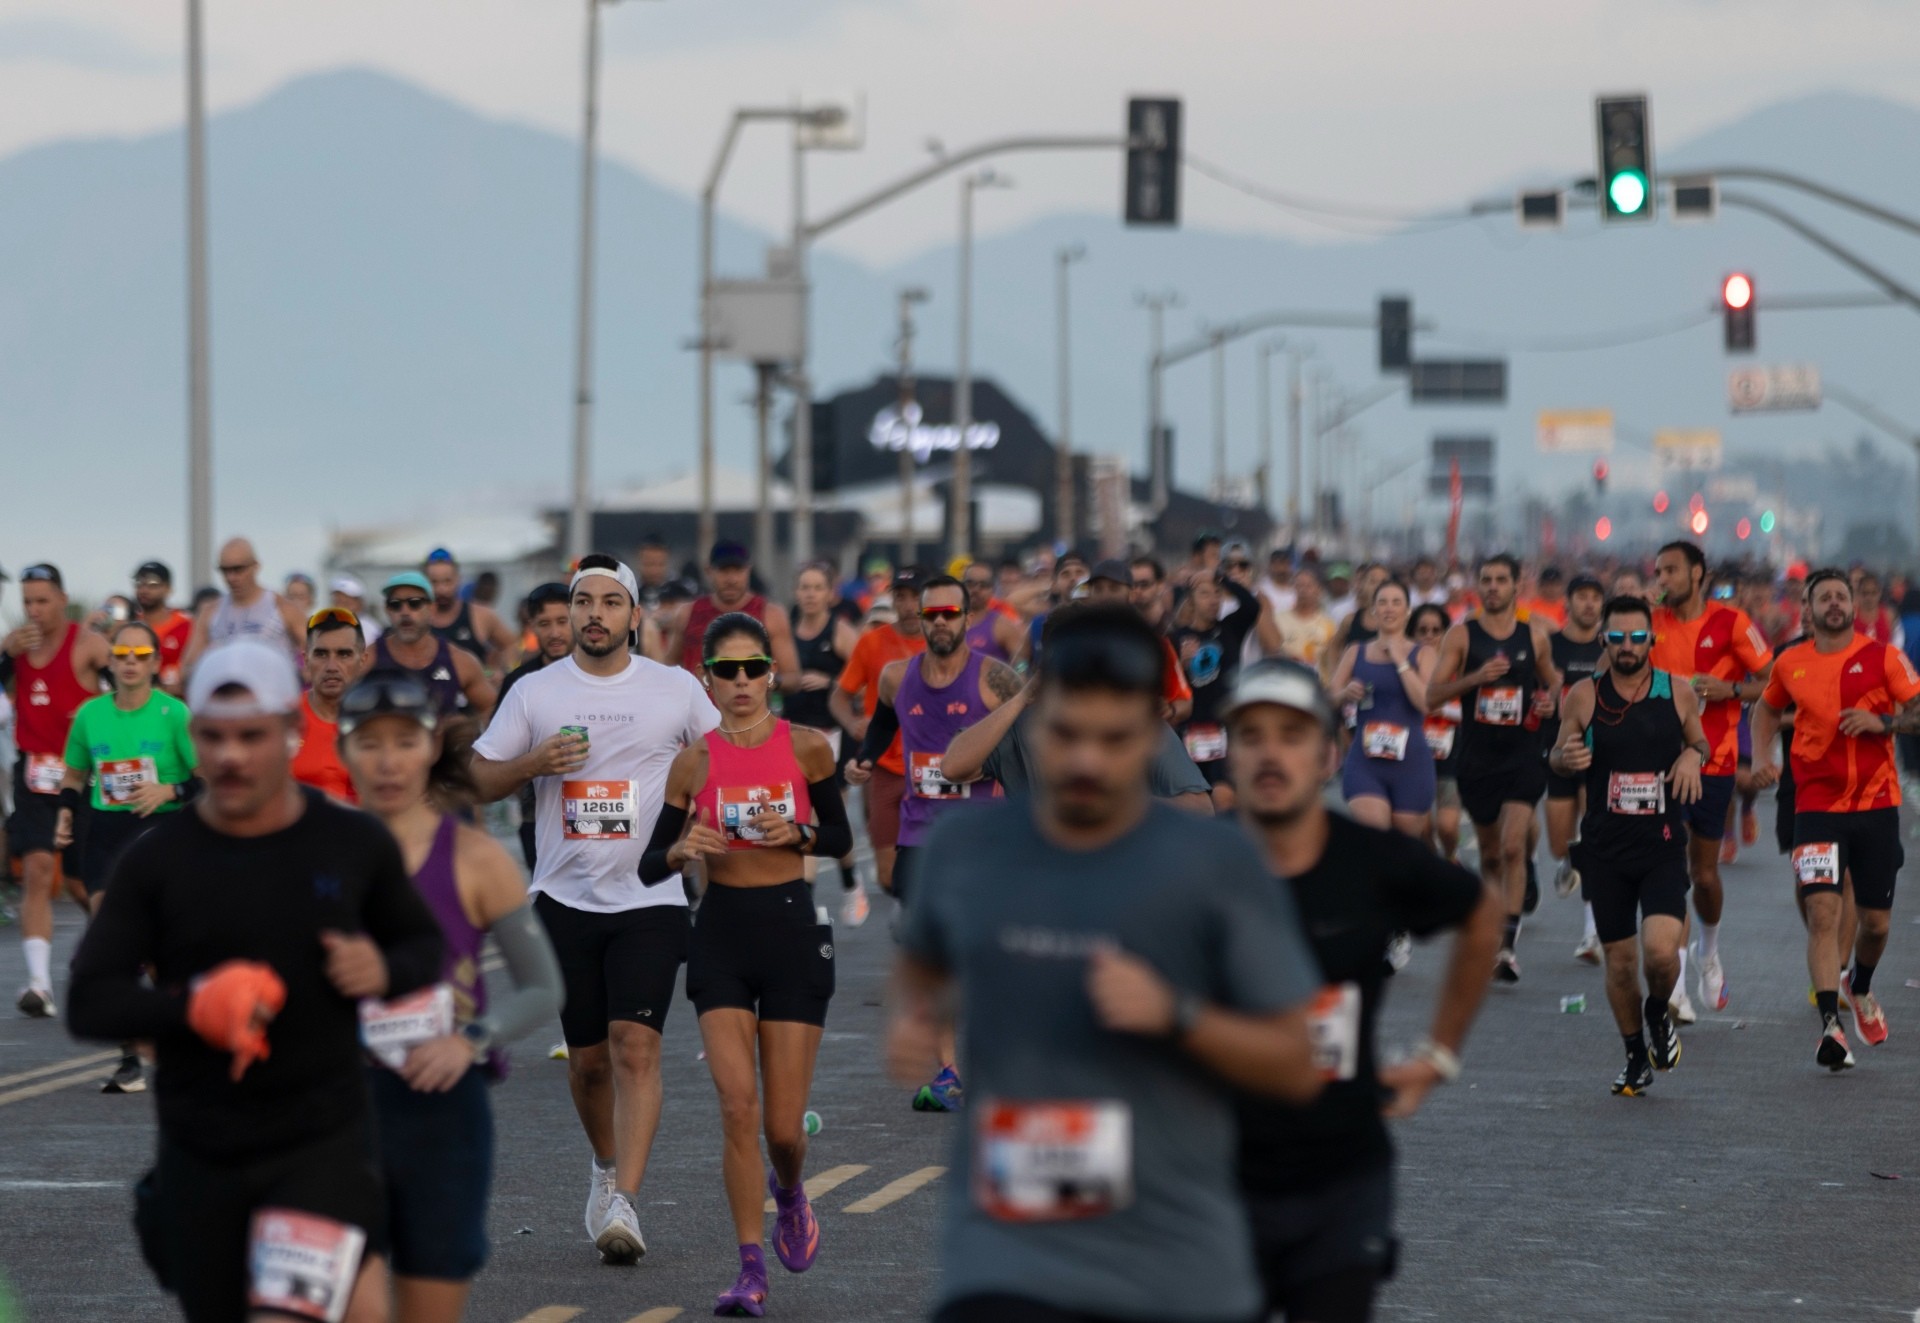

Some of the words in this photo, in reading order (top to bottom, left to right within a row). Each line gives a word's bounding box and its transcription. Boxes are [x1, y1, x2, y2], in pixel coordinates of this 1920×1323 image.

[600, 713, 635, 722] SAÚDE
[566, 801, 576, 813] H
[582, 802, 625, 813] 12616
[726, 806, 738, 819] B
